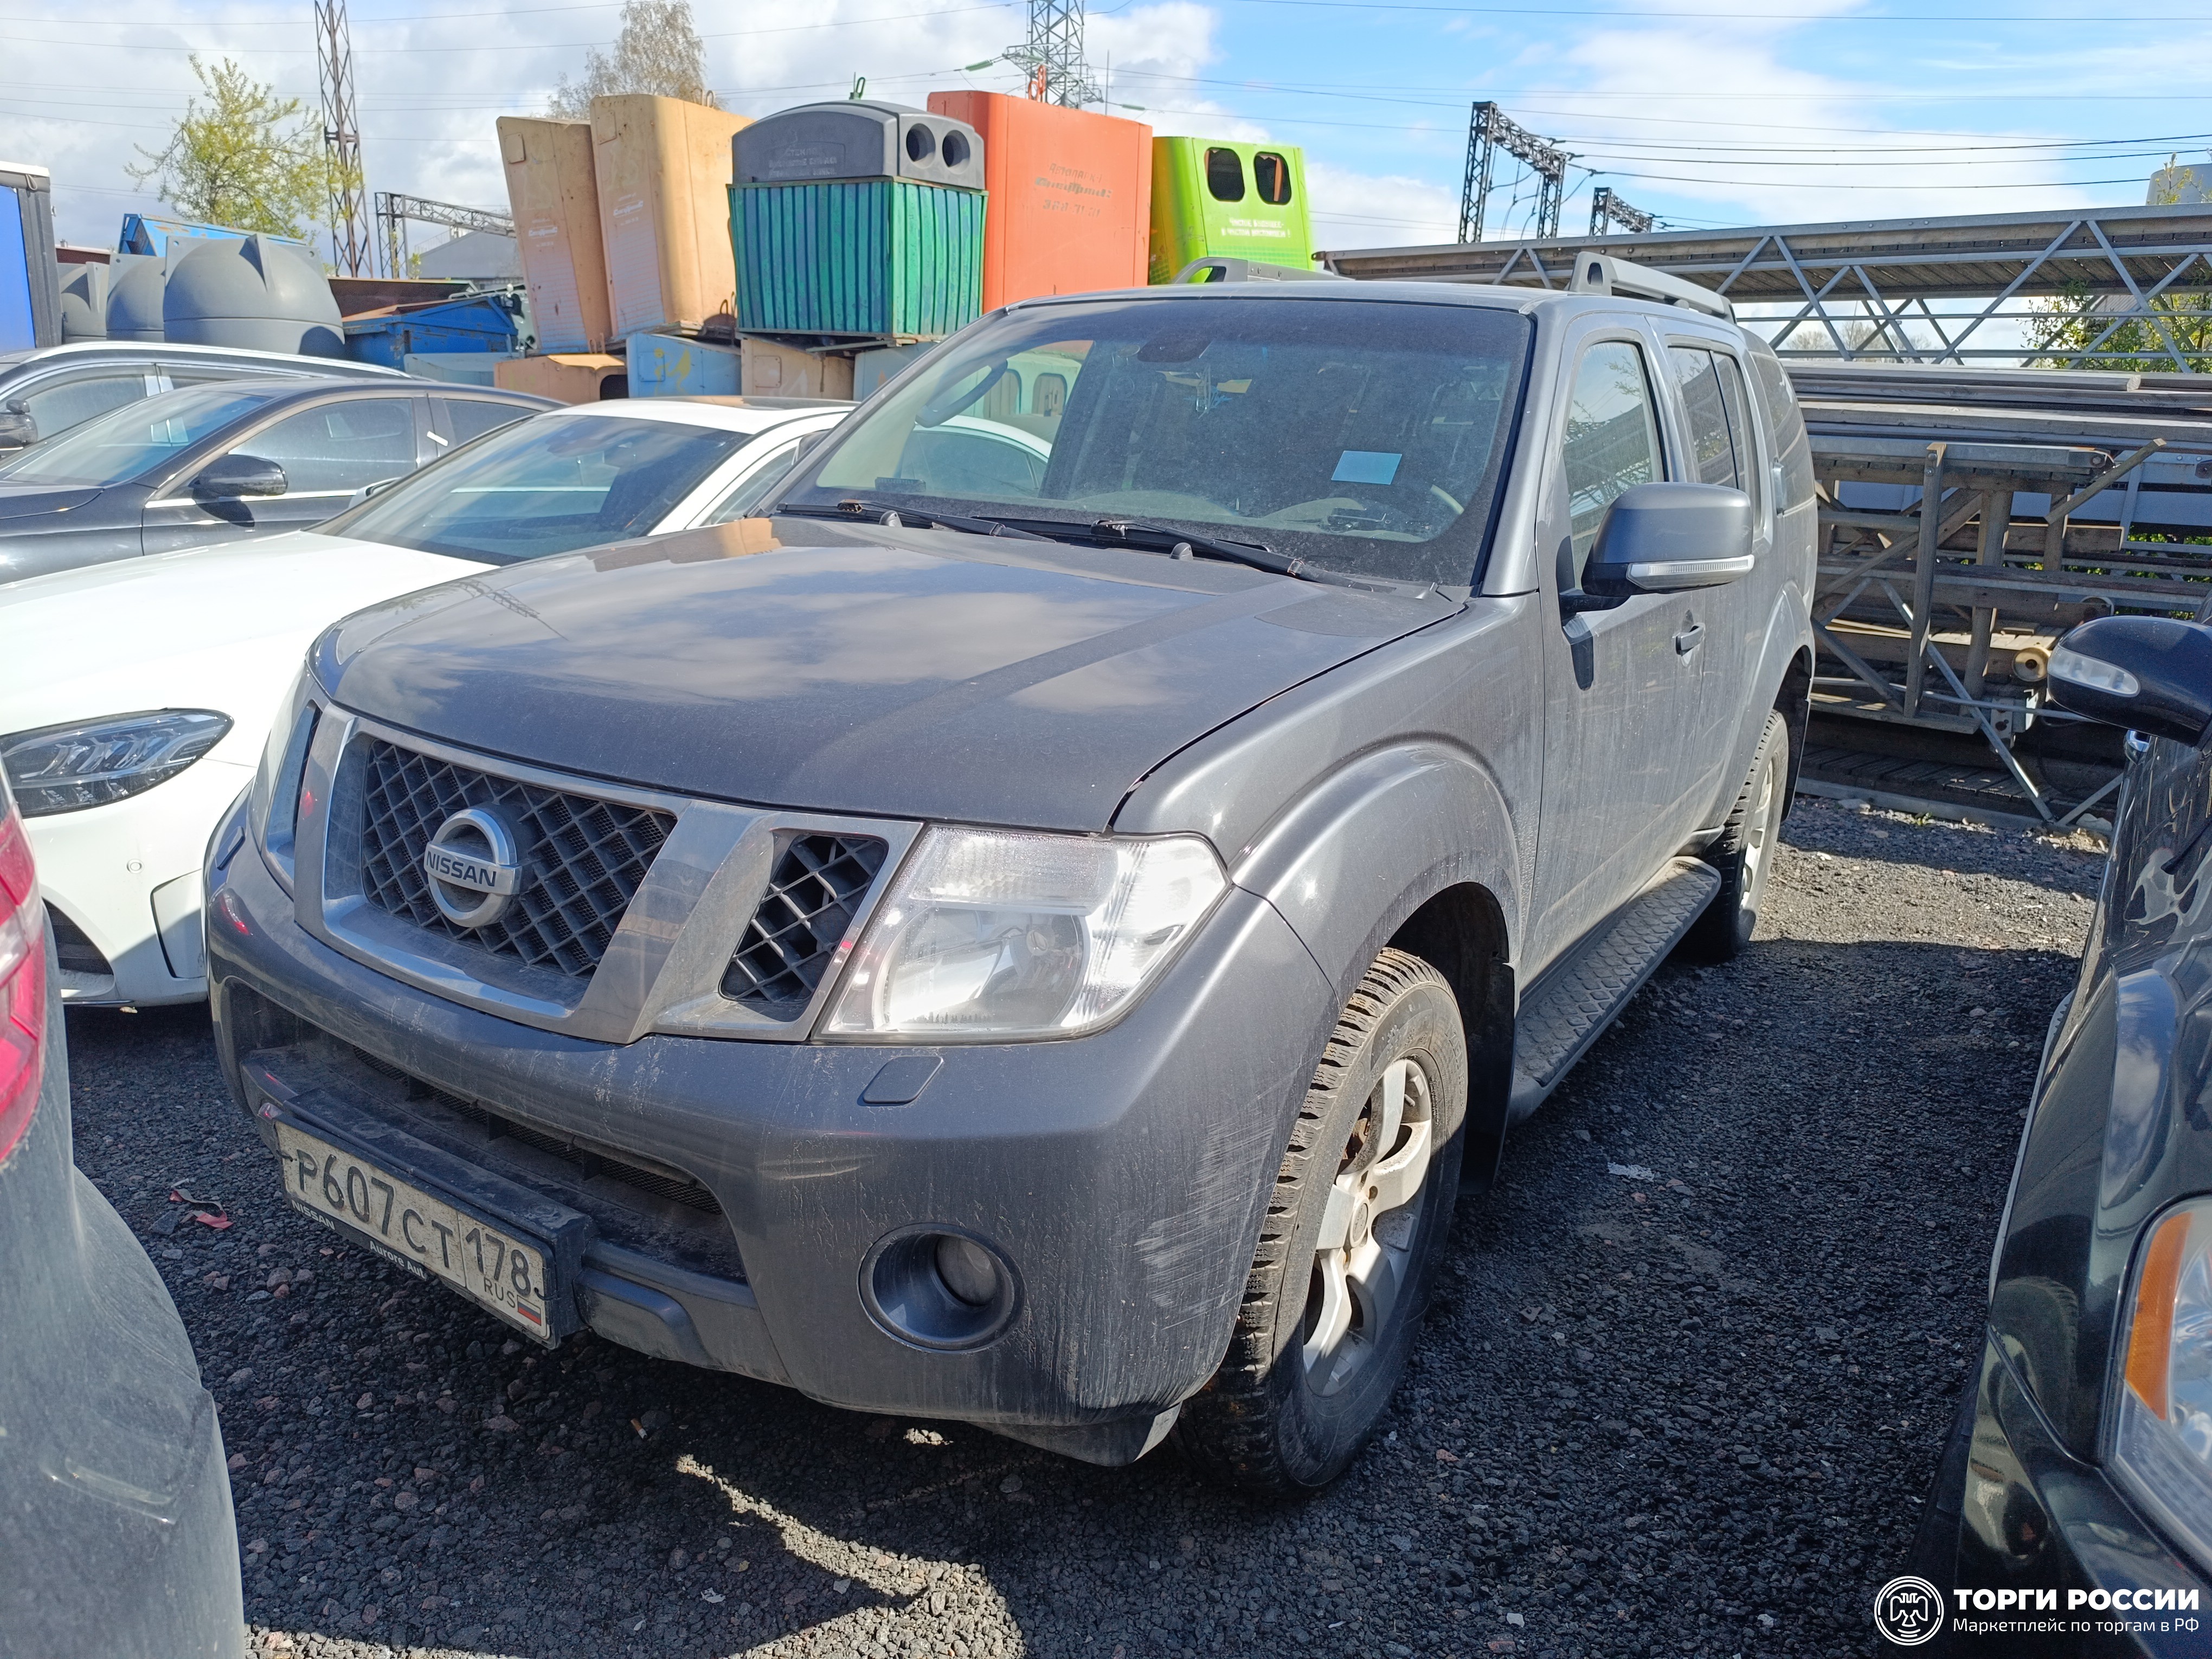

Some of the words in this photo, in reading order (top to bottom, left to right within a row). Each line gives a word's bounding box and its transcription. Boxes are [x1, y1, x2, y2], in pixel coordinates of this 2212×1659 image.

[427, 850, 497, 887] NISSAN
[291, 1199, 336, 1231] NISSAN
[370, 1240, 405, 1267] Aurore
[484, 1276, 516, 1308] RUS
